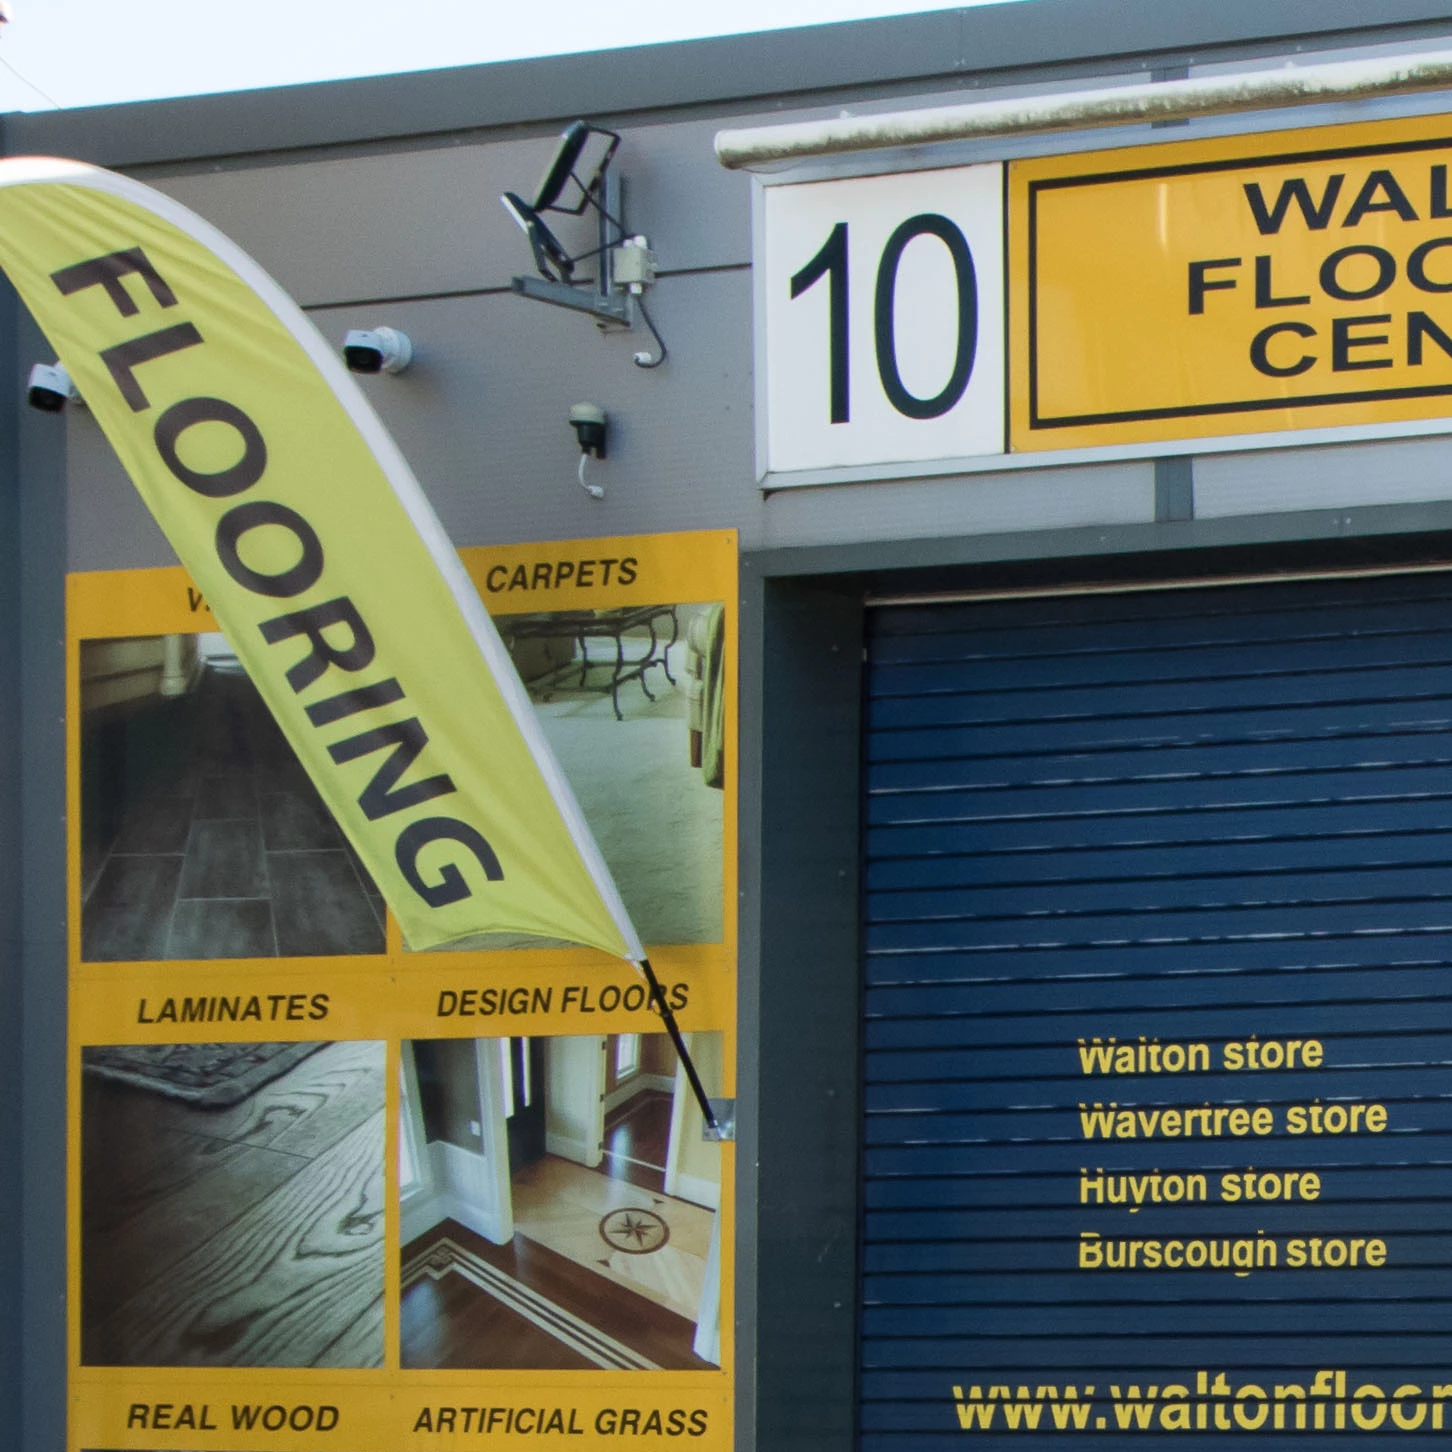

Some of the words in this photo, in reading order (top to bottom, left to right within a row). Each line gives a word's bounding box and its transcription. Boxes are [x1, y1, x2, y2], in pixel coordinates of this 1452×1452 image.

[790, 213, 978, 424] 10
[51, 246, 505, 909] FLOORING
[486, 557, 638, 593] CARPETS
[138, 994, 330, 1025] LAMINATES
[436, 988, 552, 1018] DESIGN
[562, 983, 690, 1015] FLOORS
[1077, 1037, 1210, 1074] Walton
[1223, 1034, 1323, 1070] store
[1078, 1102, 1273, 1138] Wavertree
[1287, 1098, 1388, 1134] store
[1080, 1167, 1207, 1213] Huyton
[1221, 1165, 1321, 1202] store
[1079, 1230, 1277, 1277] Burscough
[1286, 1236, 1387, 1267] store
[127, 1403, 216, 1432] REAL
[230, 1405, 340, 1433] WOOD
[413, 1407, 584, 1435] ARTIFICIAL
[595, 1408, 708, 1437] GRASS
